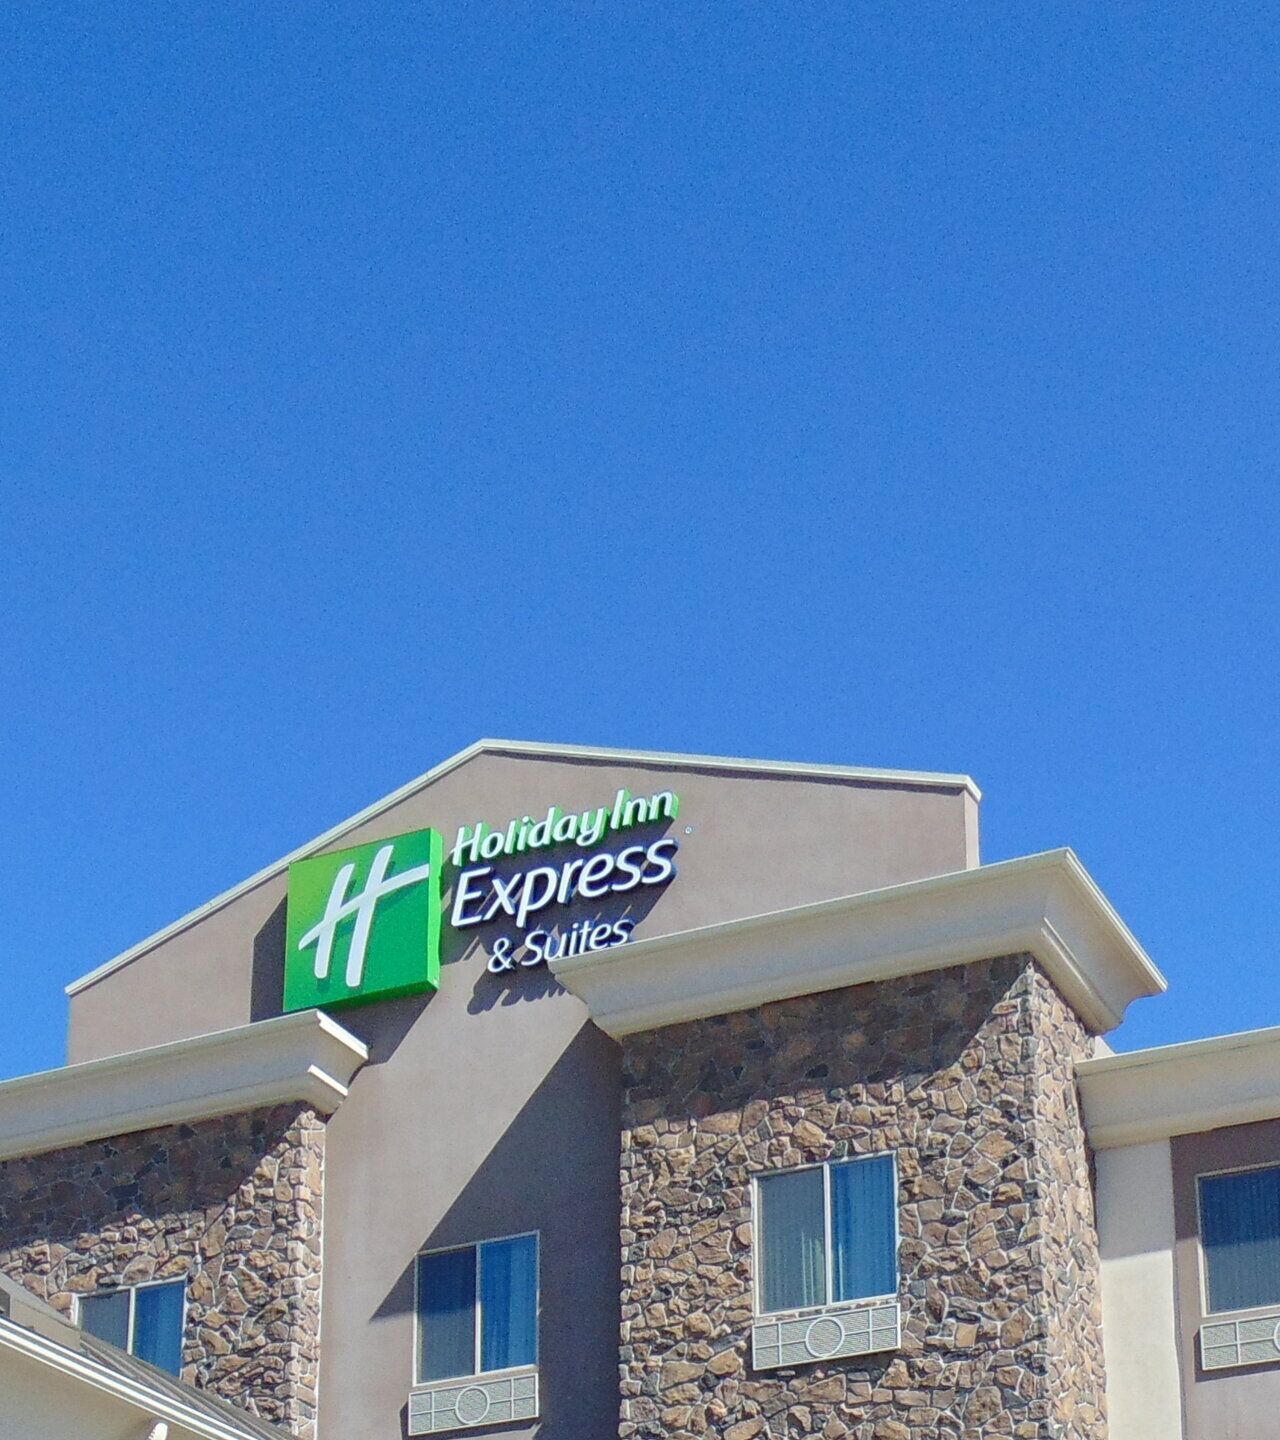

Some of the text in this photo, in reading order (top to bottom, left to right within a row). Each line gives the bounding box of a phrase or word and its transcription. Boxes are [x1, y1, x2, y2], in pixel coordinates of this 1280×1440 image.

[450, 788, 679, 866] Holiday Inn
[450, 838, 678, 929] Express
[487, 918, 635, 974] & Suites
